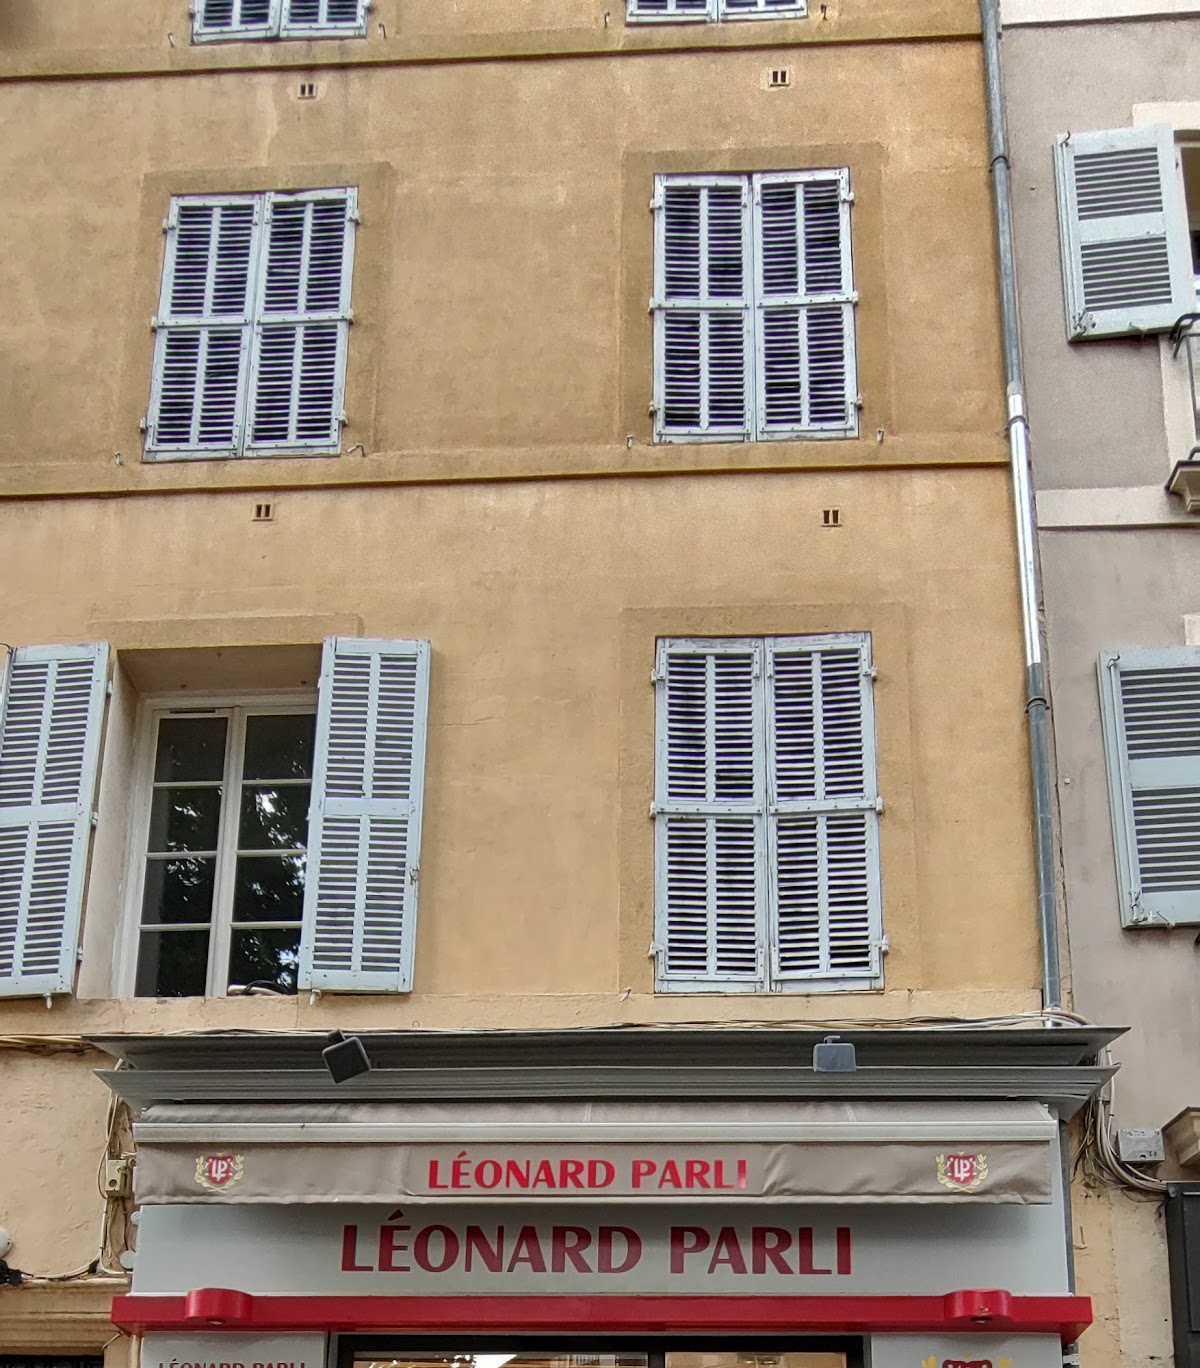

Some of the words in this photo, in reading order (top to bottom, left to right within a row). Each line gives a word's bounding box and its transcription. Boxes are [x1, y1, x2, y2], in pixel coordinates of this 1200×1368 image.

[428, 1150, 615, 1189] LÉONARD
[631, 1159, 747, 1189] PARLI
[340, 1209, 643, 1274] LÉONARD
[669, 1226, 852, 1276] PARLI
